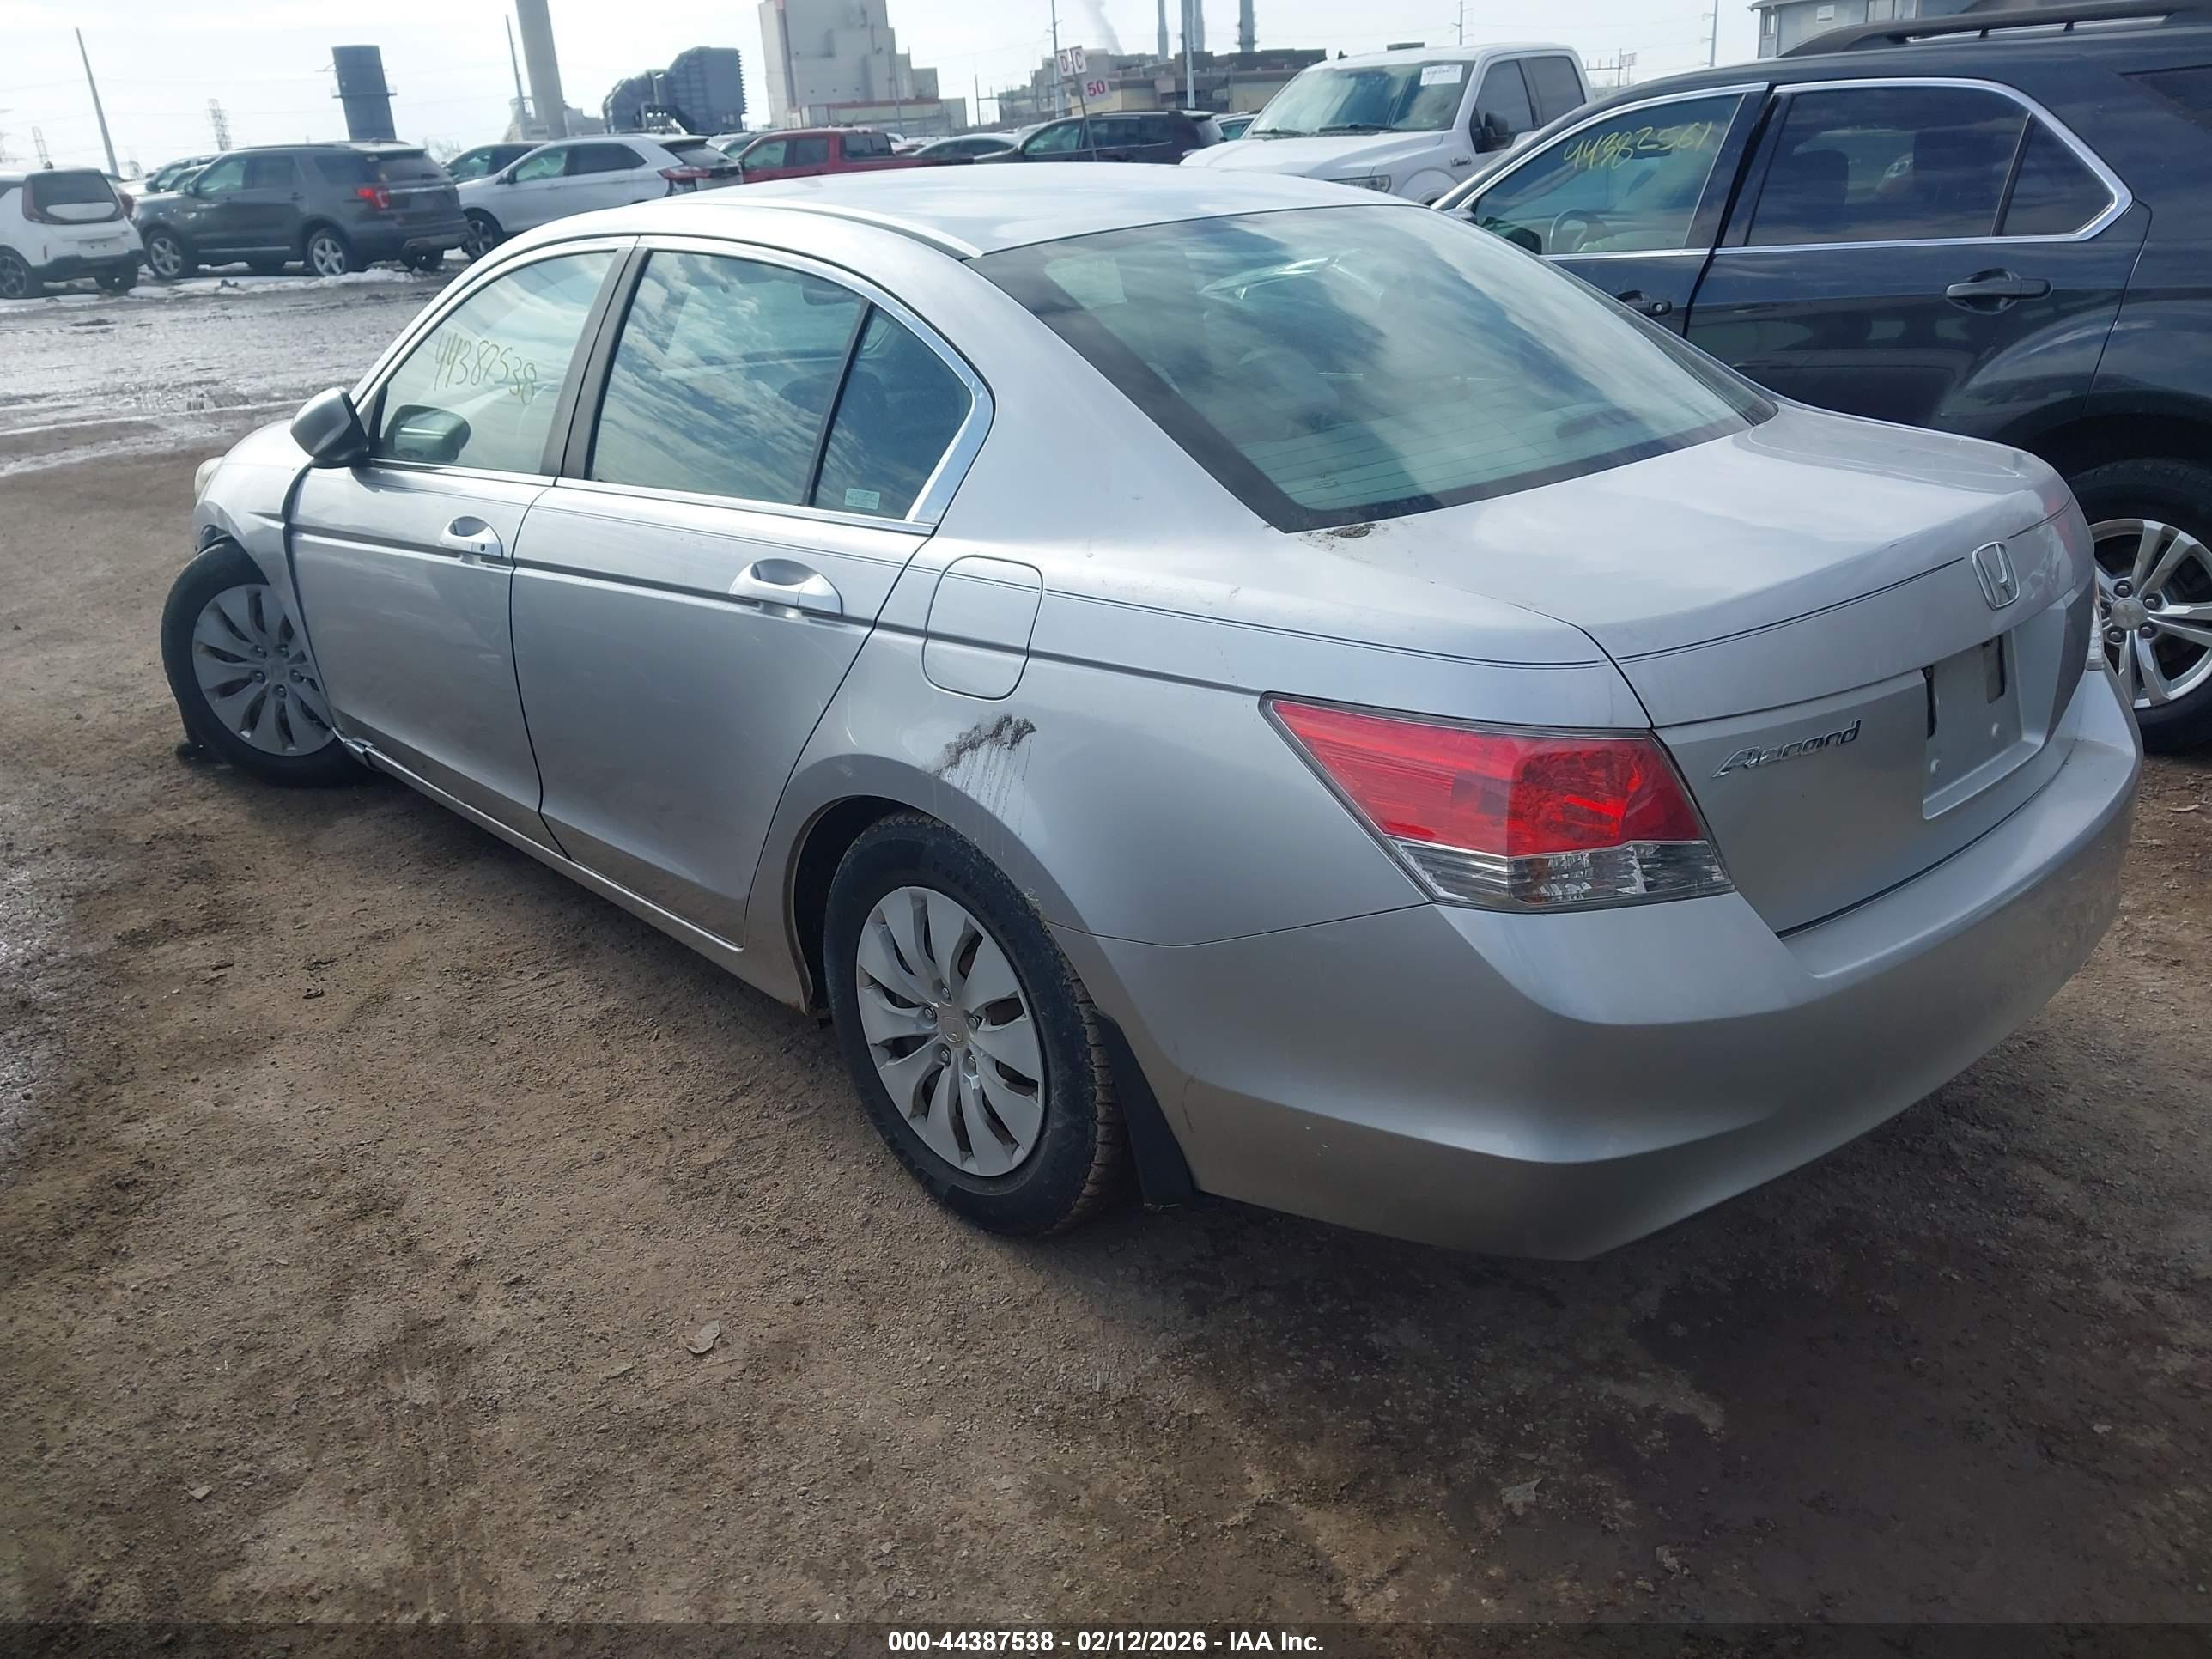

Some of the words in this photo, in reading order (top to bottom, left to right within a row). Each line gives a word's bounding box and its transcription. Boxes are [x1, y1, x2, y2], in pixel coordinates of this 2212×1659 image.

[1086, 80, 1105, 97] 50
[1564, 121, 1713, 170] 44382561
[433, 331, 538, 406] 44387538
[1711, 719, 1862, 779] Accord
